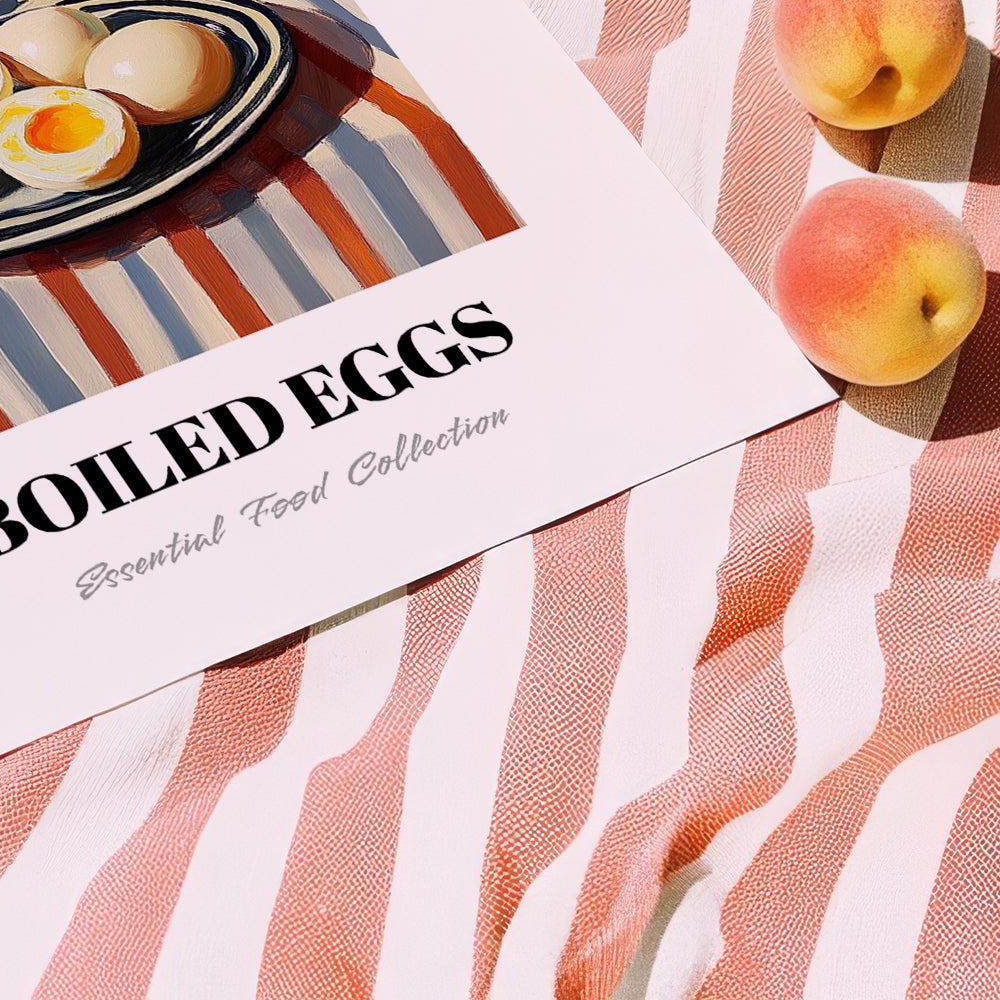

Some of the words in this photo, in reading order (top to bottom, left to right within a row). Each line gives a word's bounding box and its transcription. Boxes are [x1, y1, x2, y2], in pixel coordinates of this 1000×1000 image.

[278, 299, 514, 430] EGGS
[75, 513, 227, 601] Essential
[239, 470, 330, 528] Food
[347, 407, 511, 487] Collection
